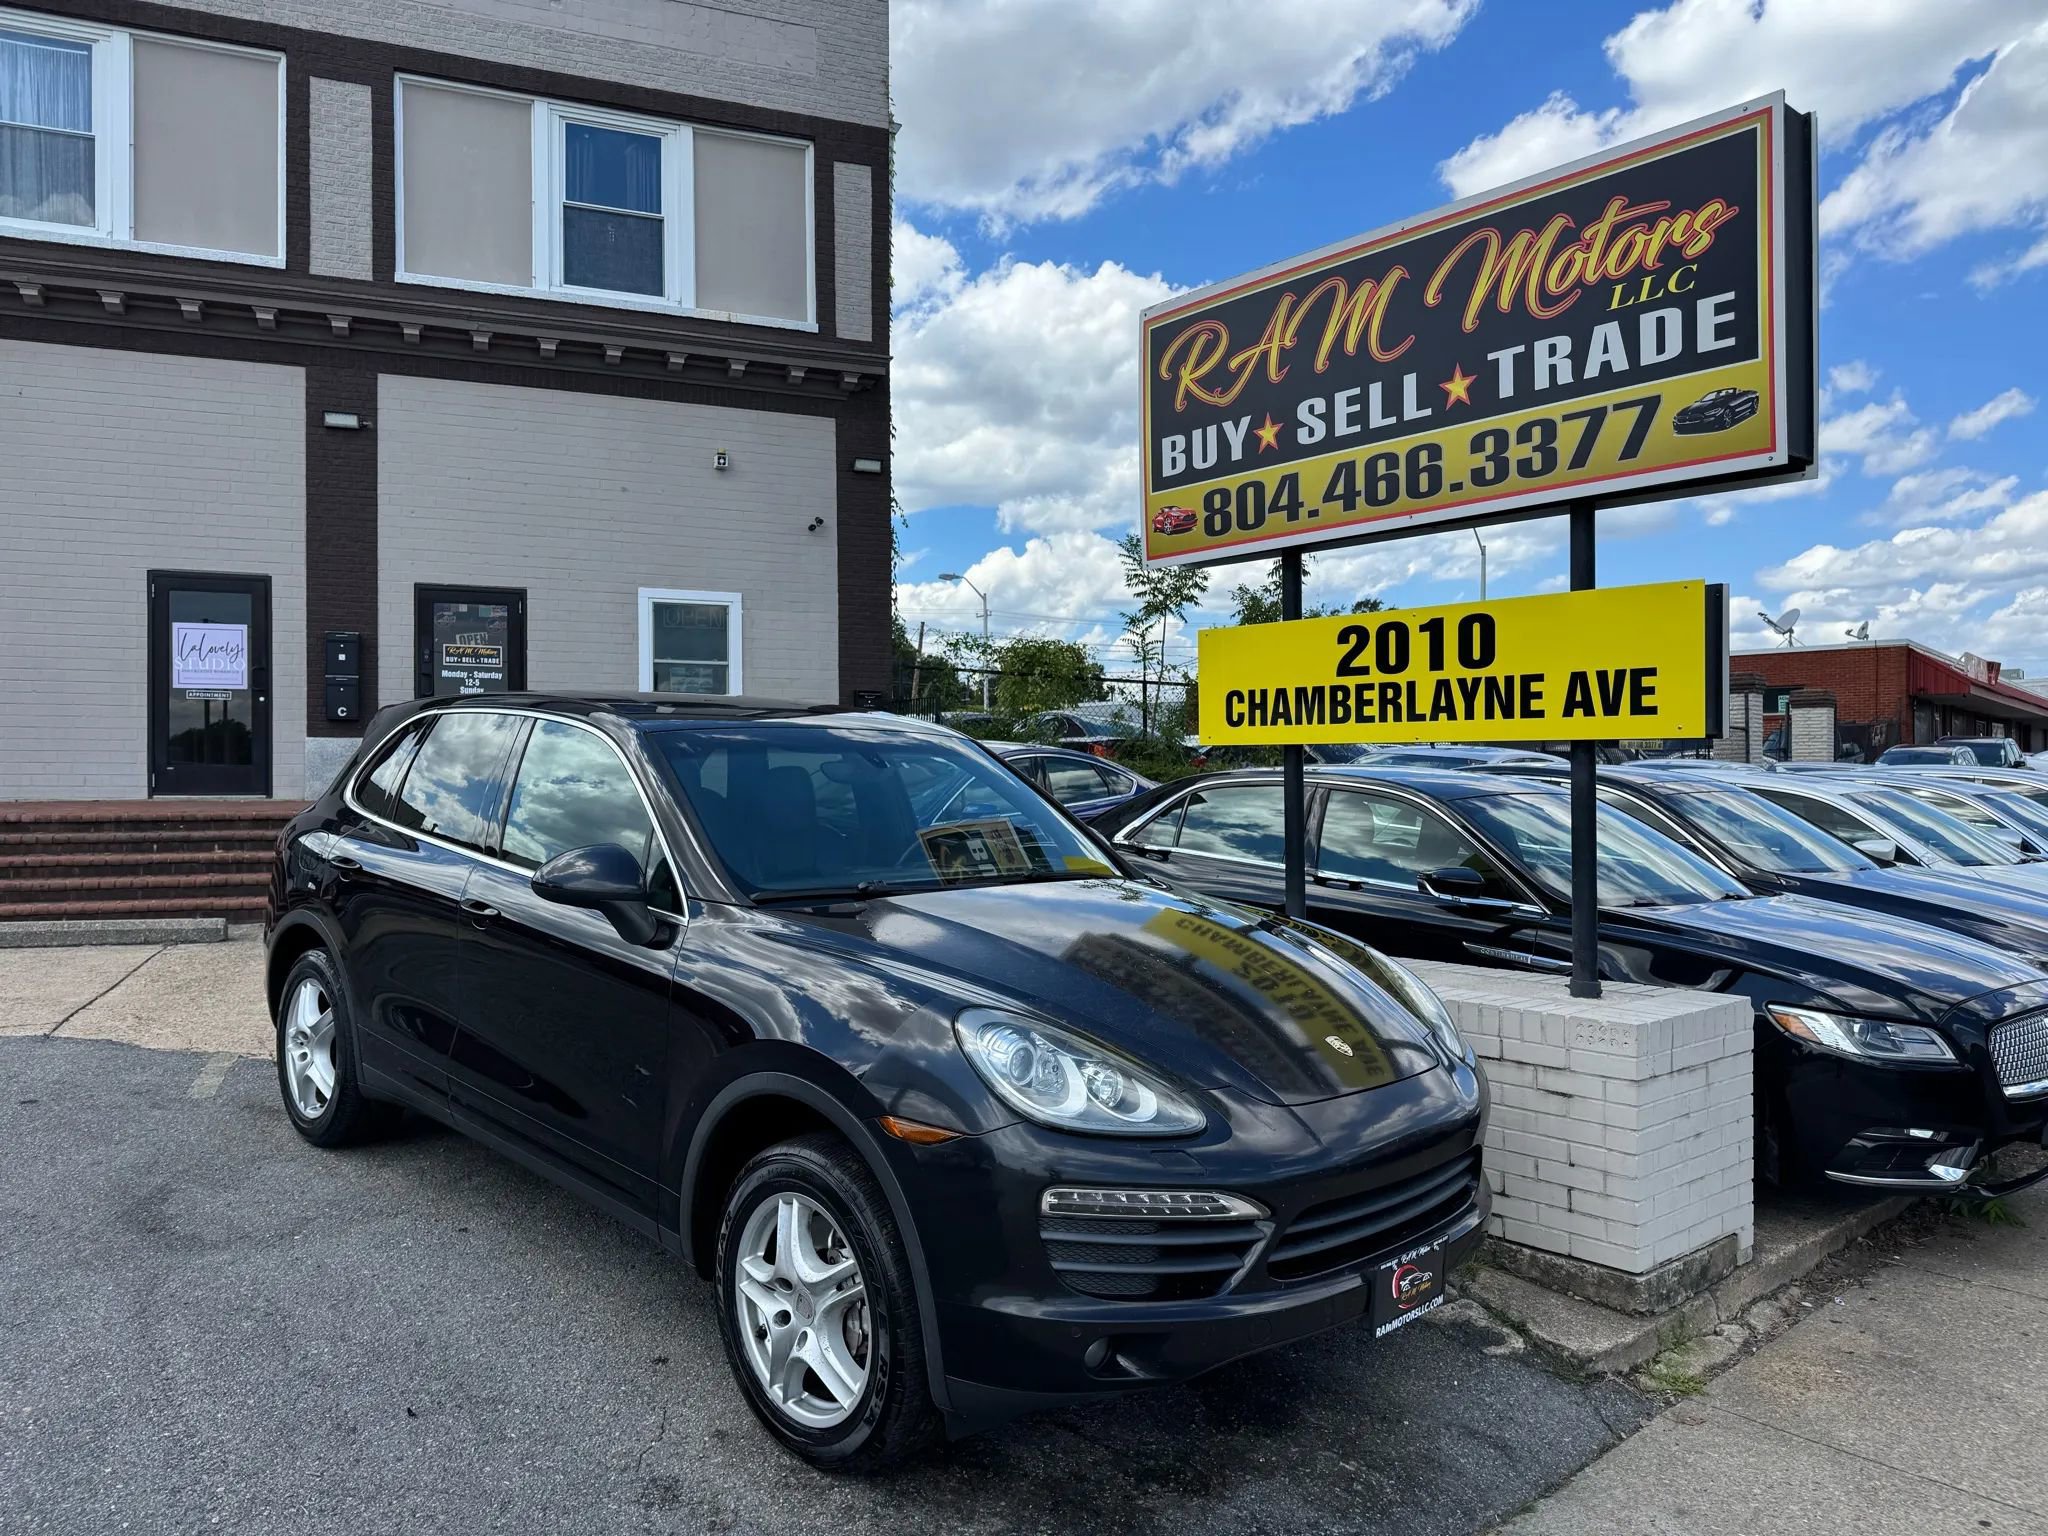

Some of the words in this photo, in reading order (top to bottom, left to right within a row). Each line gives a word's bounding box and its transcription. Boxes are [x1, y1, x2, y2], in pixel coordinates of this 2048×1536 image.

[1159, 265, 1415, 412] RAM
[1425, 195, 1739, 333] Motors
[1606, 264, 1698, 311] LLC
[1161, 415, 1252, 478] BUY
[1297, 372, 1432, 445] SELL
[1487, 290, 1736, 399] TRADE
[1202, 394, 1662, 538] 804.466.3377
[458, 632, 488, 646] OPEN
[1335, 612, 1496, 677] 2010
[441, 670, 468, 679] Monday
[473, 671, 503, 680] Saturday
[460, 686, 484, 694] Sunday
[465, 679, 480, 687] 12-5
[1225, 672, 1545, 728] CHAMBERLAYNE
[1562, 666, 1658, 719] AVE
[337, 706, 348, 717] C
